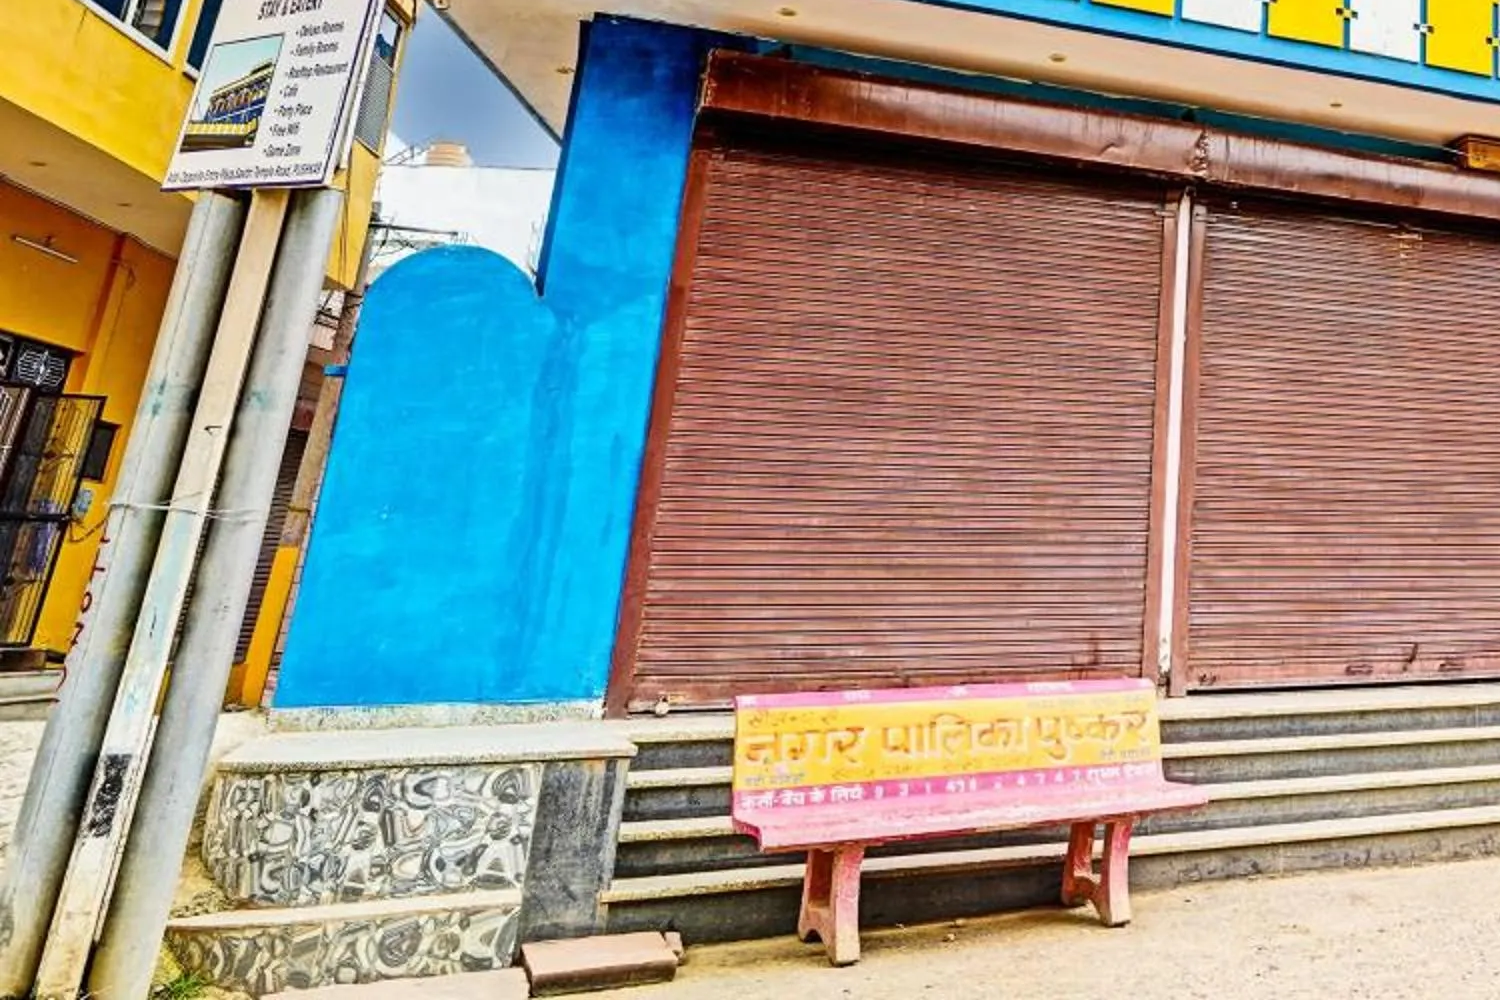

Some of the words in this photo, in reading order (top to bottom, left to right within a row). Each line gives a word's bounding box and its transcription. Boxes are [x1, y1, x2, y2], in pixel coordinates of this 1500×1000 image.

[258, 0, 283, 20] STAY
[741, 726, 868, 768] नगर
[882, 712, 1030, 760] पालिका
